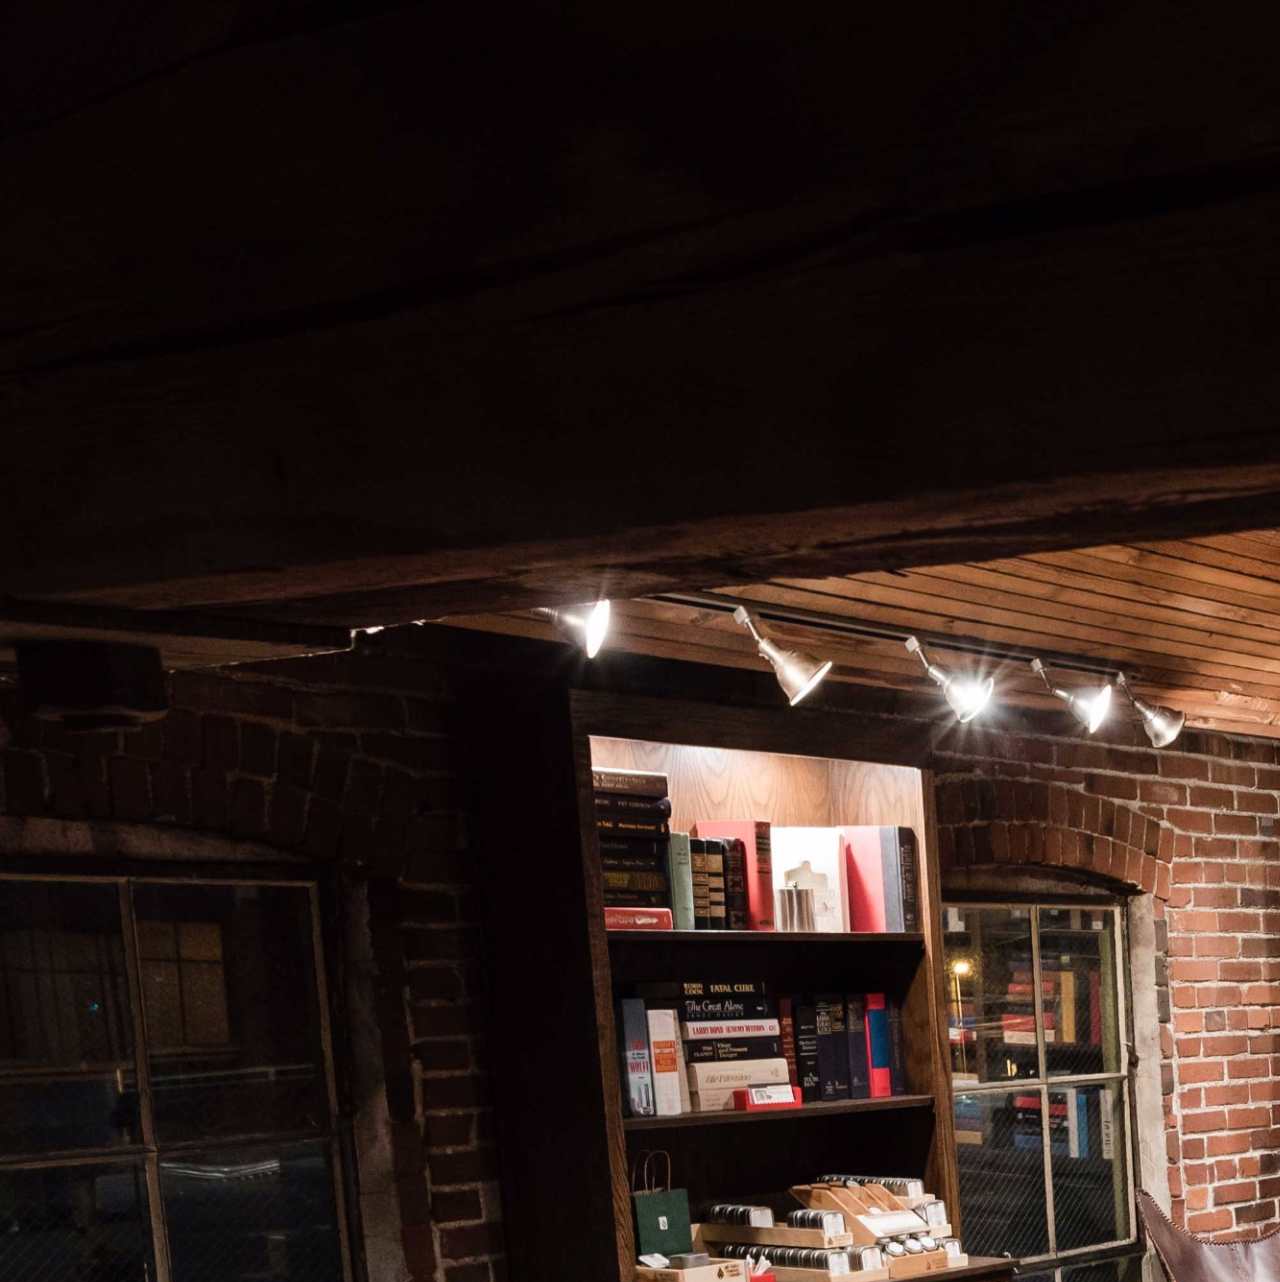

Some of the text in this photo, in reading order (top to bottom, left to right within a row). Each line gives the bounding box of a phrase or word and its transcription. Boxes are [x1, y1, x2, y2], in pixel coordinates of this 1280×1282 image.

[710, 984, 755, 993] FATAL CURE
[685, 1001, 701, 1012] The
